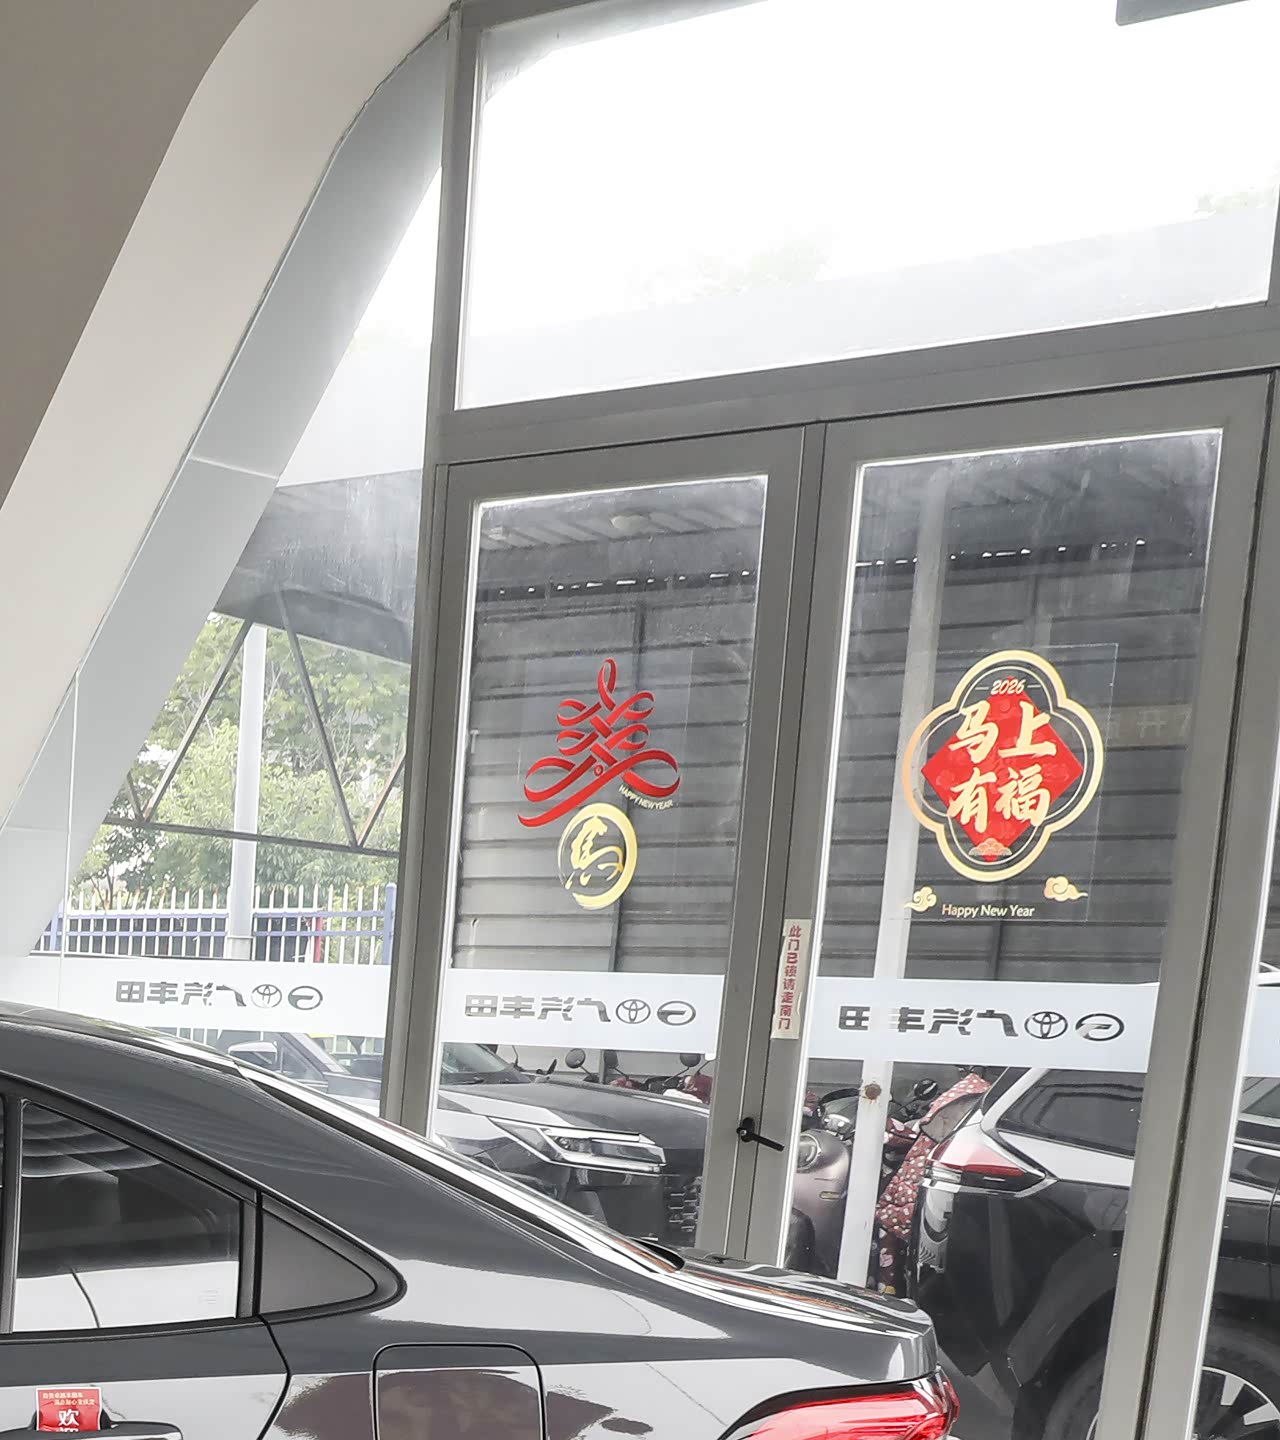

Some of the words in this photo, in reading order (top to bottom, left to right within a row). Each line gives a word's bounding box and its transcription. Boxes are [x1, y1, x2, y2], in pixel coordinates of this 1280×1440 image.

[991, 679, 1027, 695] 2026
[949, 700, 1057, 764] 马上
[948, 764, 1051, 833] 有福
[942, 904, 979, 918] Happy
[980, 905, 1008, 917] New
[1009, 905, 1035, 917] Year
[778, 925, 802, 1030] 此门已锁请走南门
